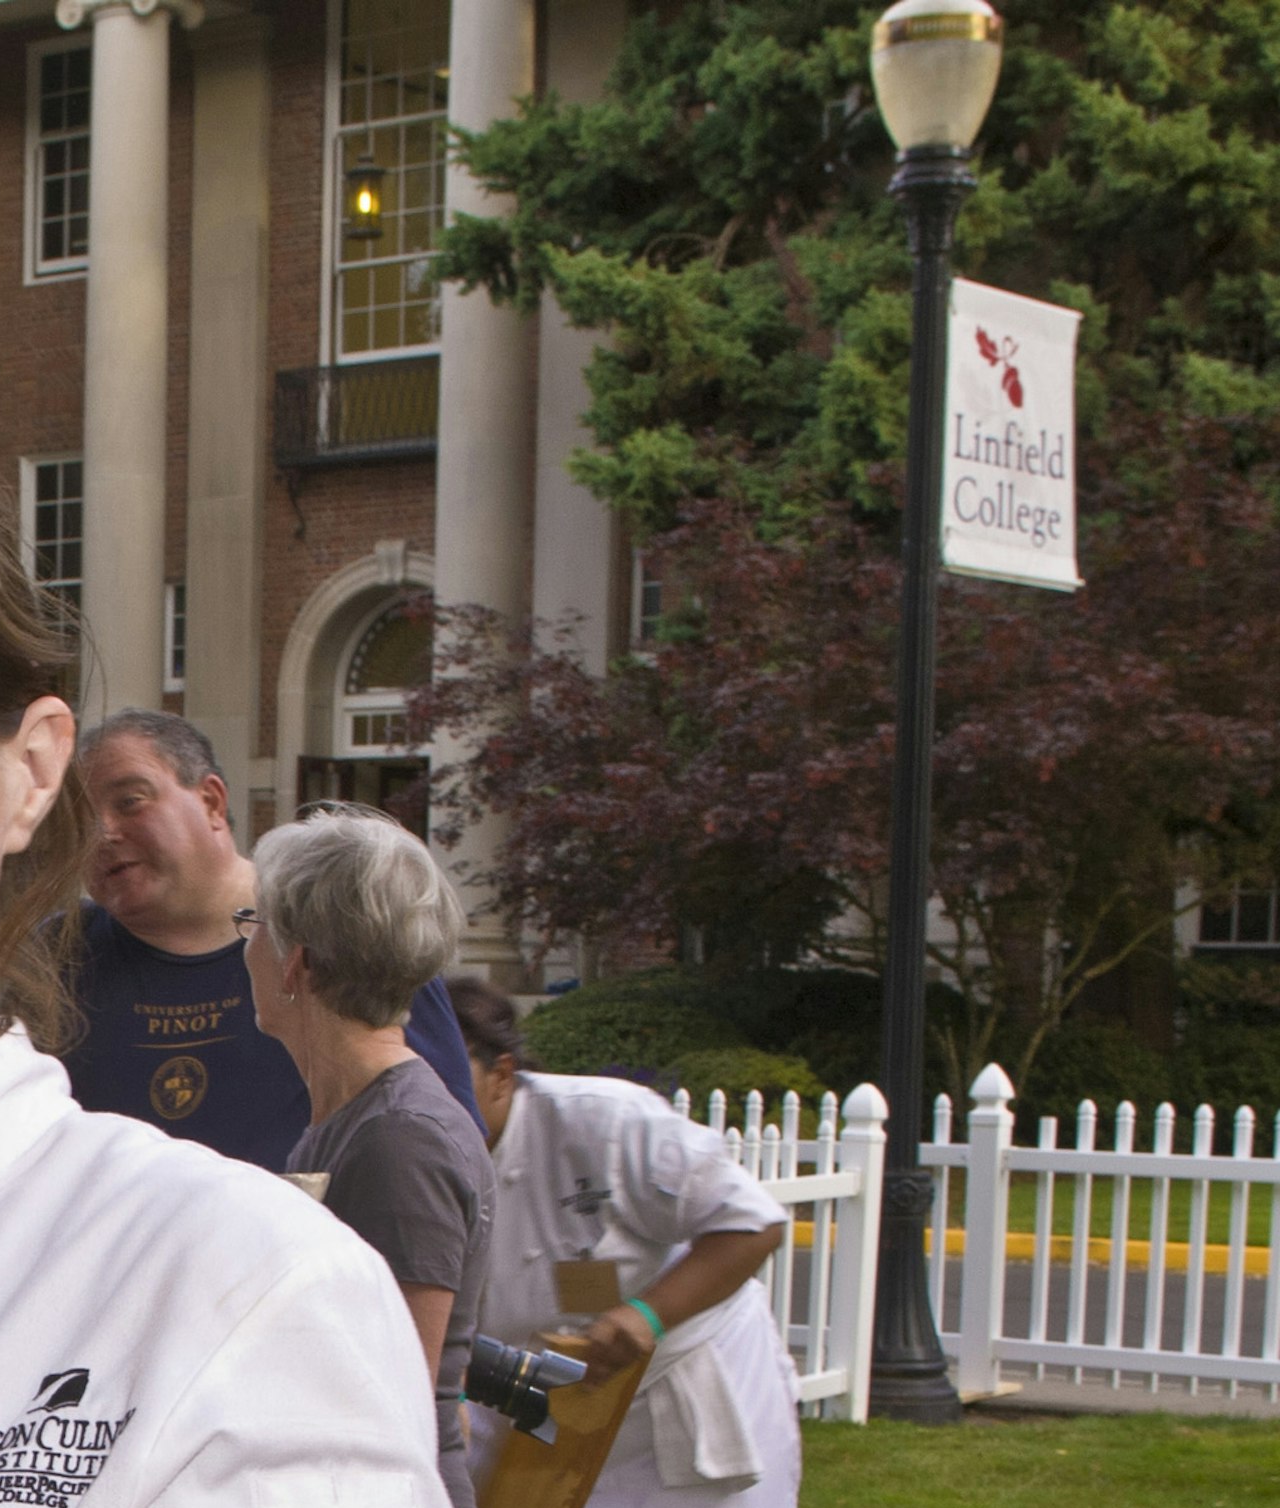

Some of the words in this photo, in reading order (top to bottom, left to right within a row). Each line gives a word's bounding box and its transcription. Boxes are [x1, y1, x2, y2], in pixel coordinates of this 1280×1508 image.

[954, 413, 1064, 480] Linfield
[953, 475, 1061, 549] College
[133, 1001, 218, 1016] UNIVERSITY
[222, 996, 242, 1009] OF
[148, 1012, 223, 1035] PINOT
[36, 1408, 136, 1451] CULIN
